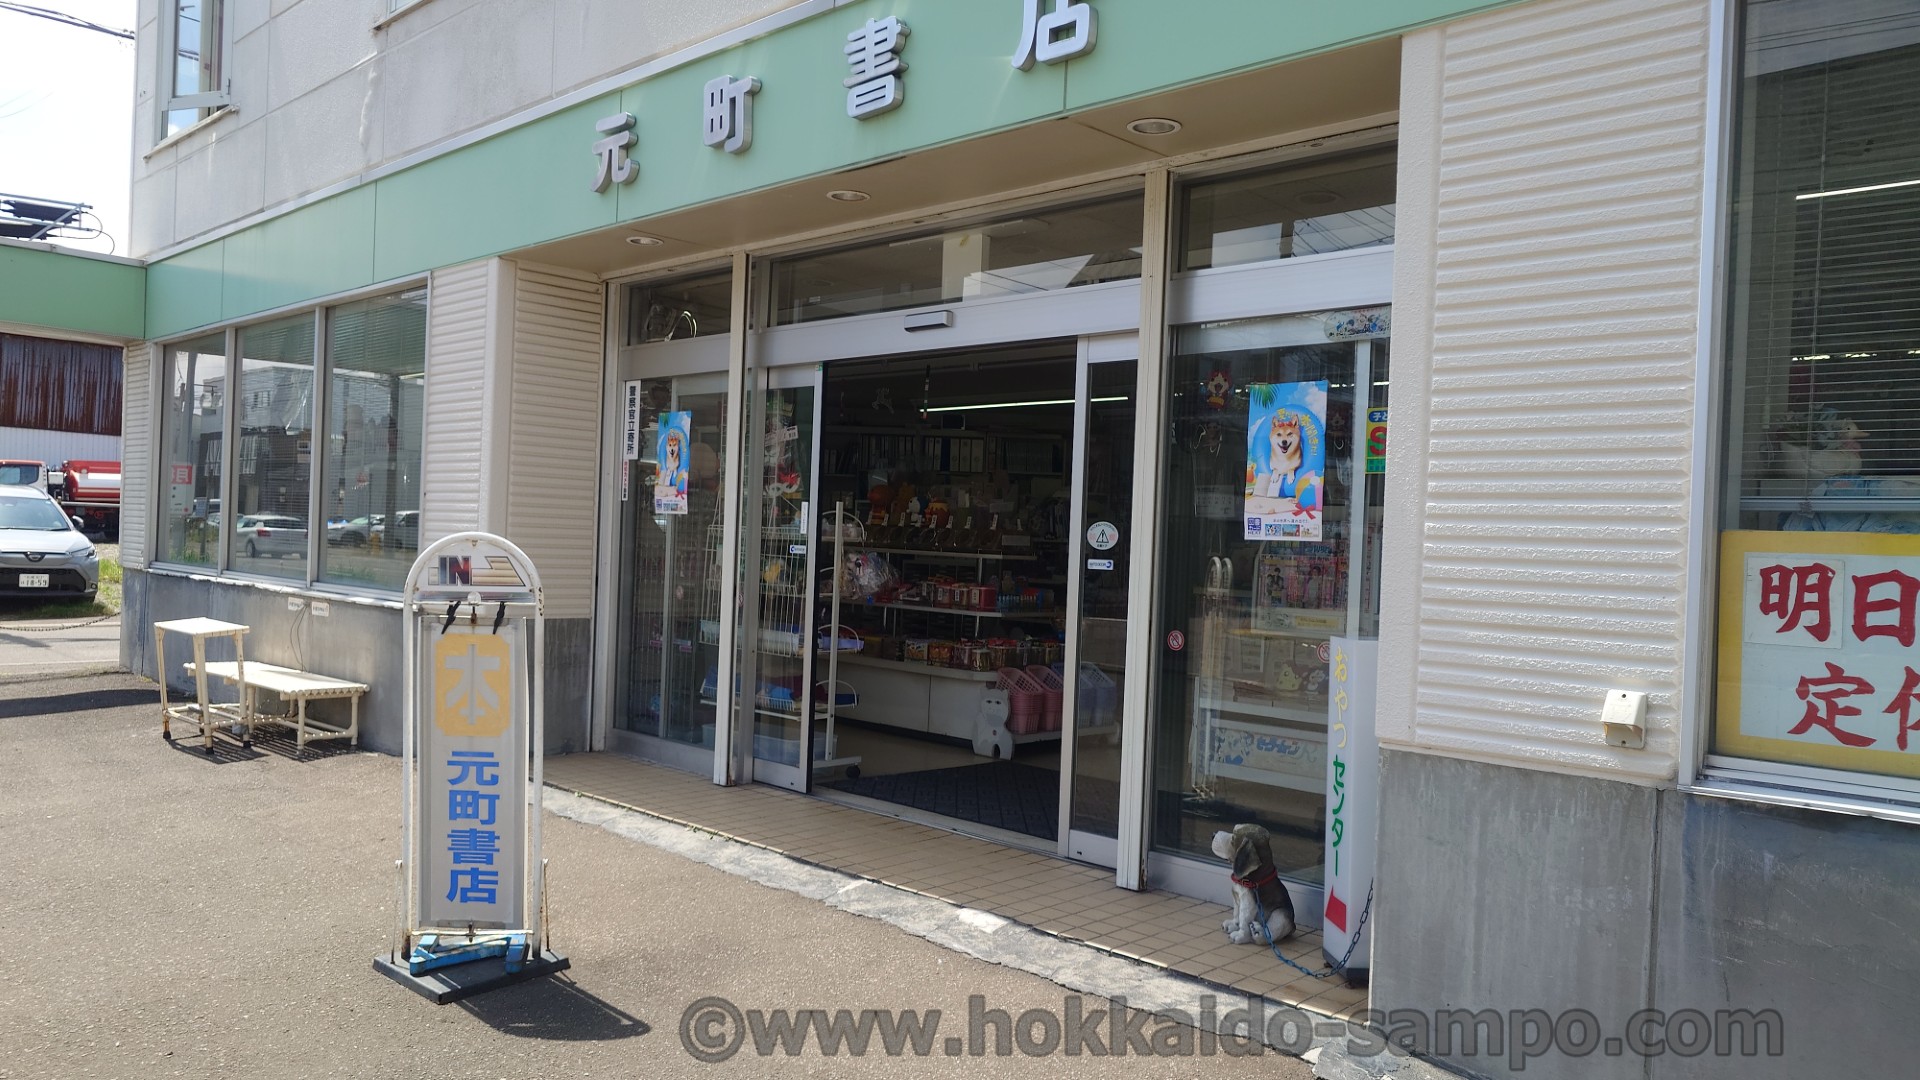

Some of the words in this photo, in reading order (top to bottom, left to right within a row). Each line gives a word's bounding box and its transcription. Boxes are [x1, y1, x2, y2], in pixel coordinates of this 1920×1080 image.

[626, 385, 637, 455] 警察官立寄所
[1759, 562, 1920, 648] 明日
[1332, 645, 1349, 877] おやつセンター
[446, 750, 501, 905] 元町書店
